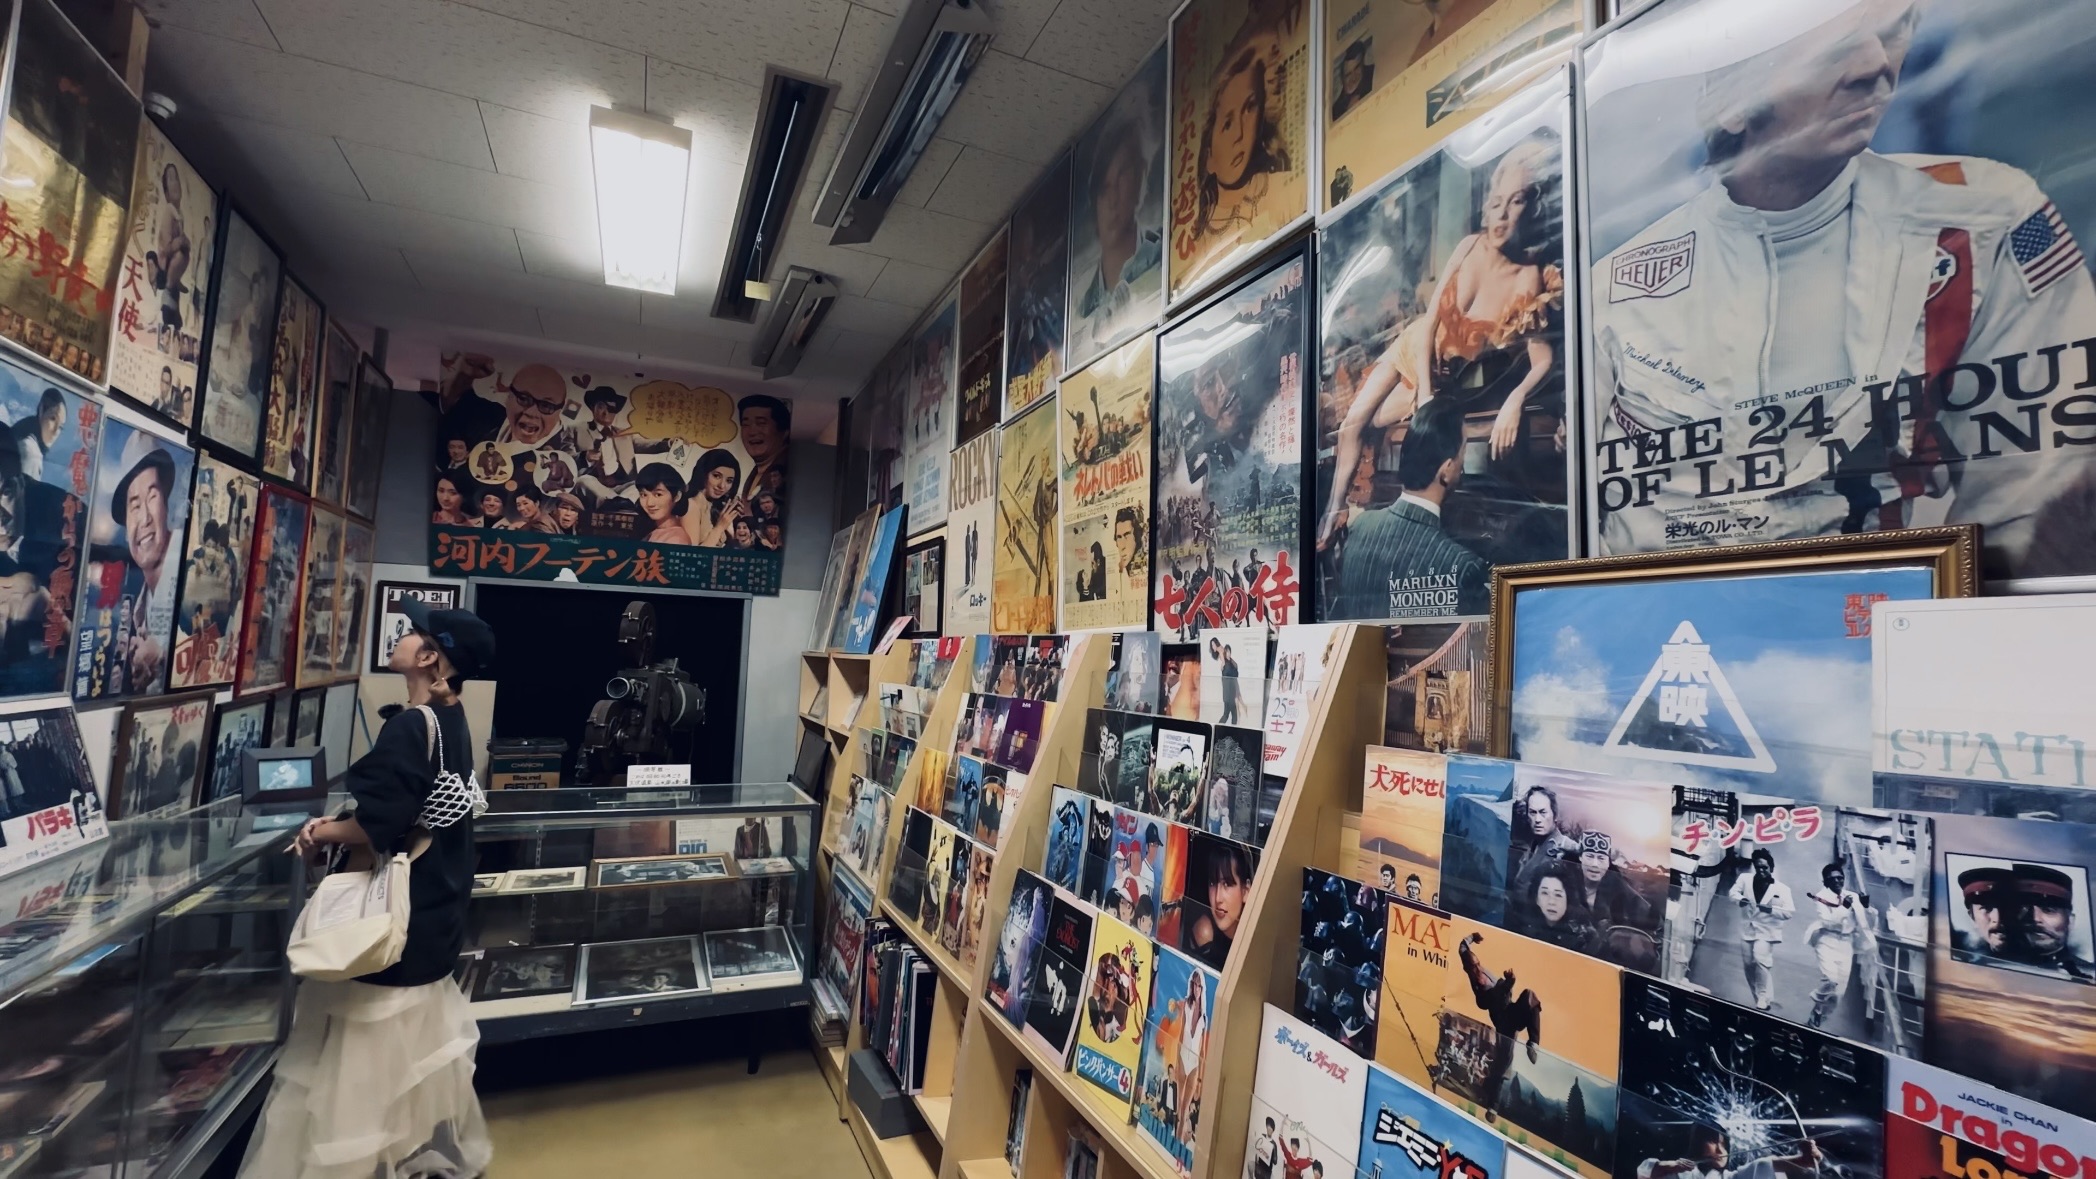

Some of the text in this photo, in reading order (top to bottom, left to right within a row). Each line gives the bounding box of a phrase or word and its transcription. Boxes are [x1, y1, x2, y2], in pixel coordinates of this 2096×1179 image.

[1615, 239, 1691, 265] CHRONOGRAPH
[1621, 255, 1683, 288] HEUER
[1734, 373, 1878, 411] STEVE McQUEEN in
[1597, 416, 1724, 475] THE
[1748, 394, 1834, 449] 24
[1600, 394, 2096, 512] OF LE MANS
[950, 431, 995, 513] ROCKY
[1665, 505, 1696, 515] Directed
[1708, 501, 1728, 509] John
[1665, 515, 1770, 540] 栄光のル・マン
[434, 532, 672, 584] 河内フーテン族
[389, 588, 451, 604] TOEI
[1155, 549, 1300, 630] 七人の侍
[1389, 574, 1458, 592] MARILYN
[1390, 589, 1459, 608] MONROE
[1389, 608, 1439, 618] REMEMBER
[1658, 643, 1711, 728] 東映
[28, 806, 74, 841] バラキ
[1407, 943, 1449, 970] in Whi
[1958, 1092, 2059, 1133] JACKIE CHAN
[2002, 1116, 2013, 1127] in
